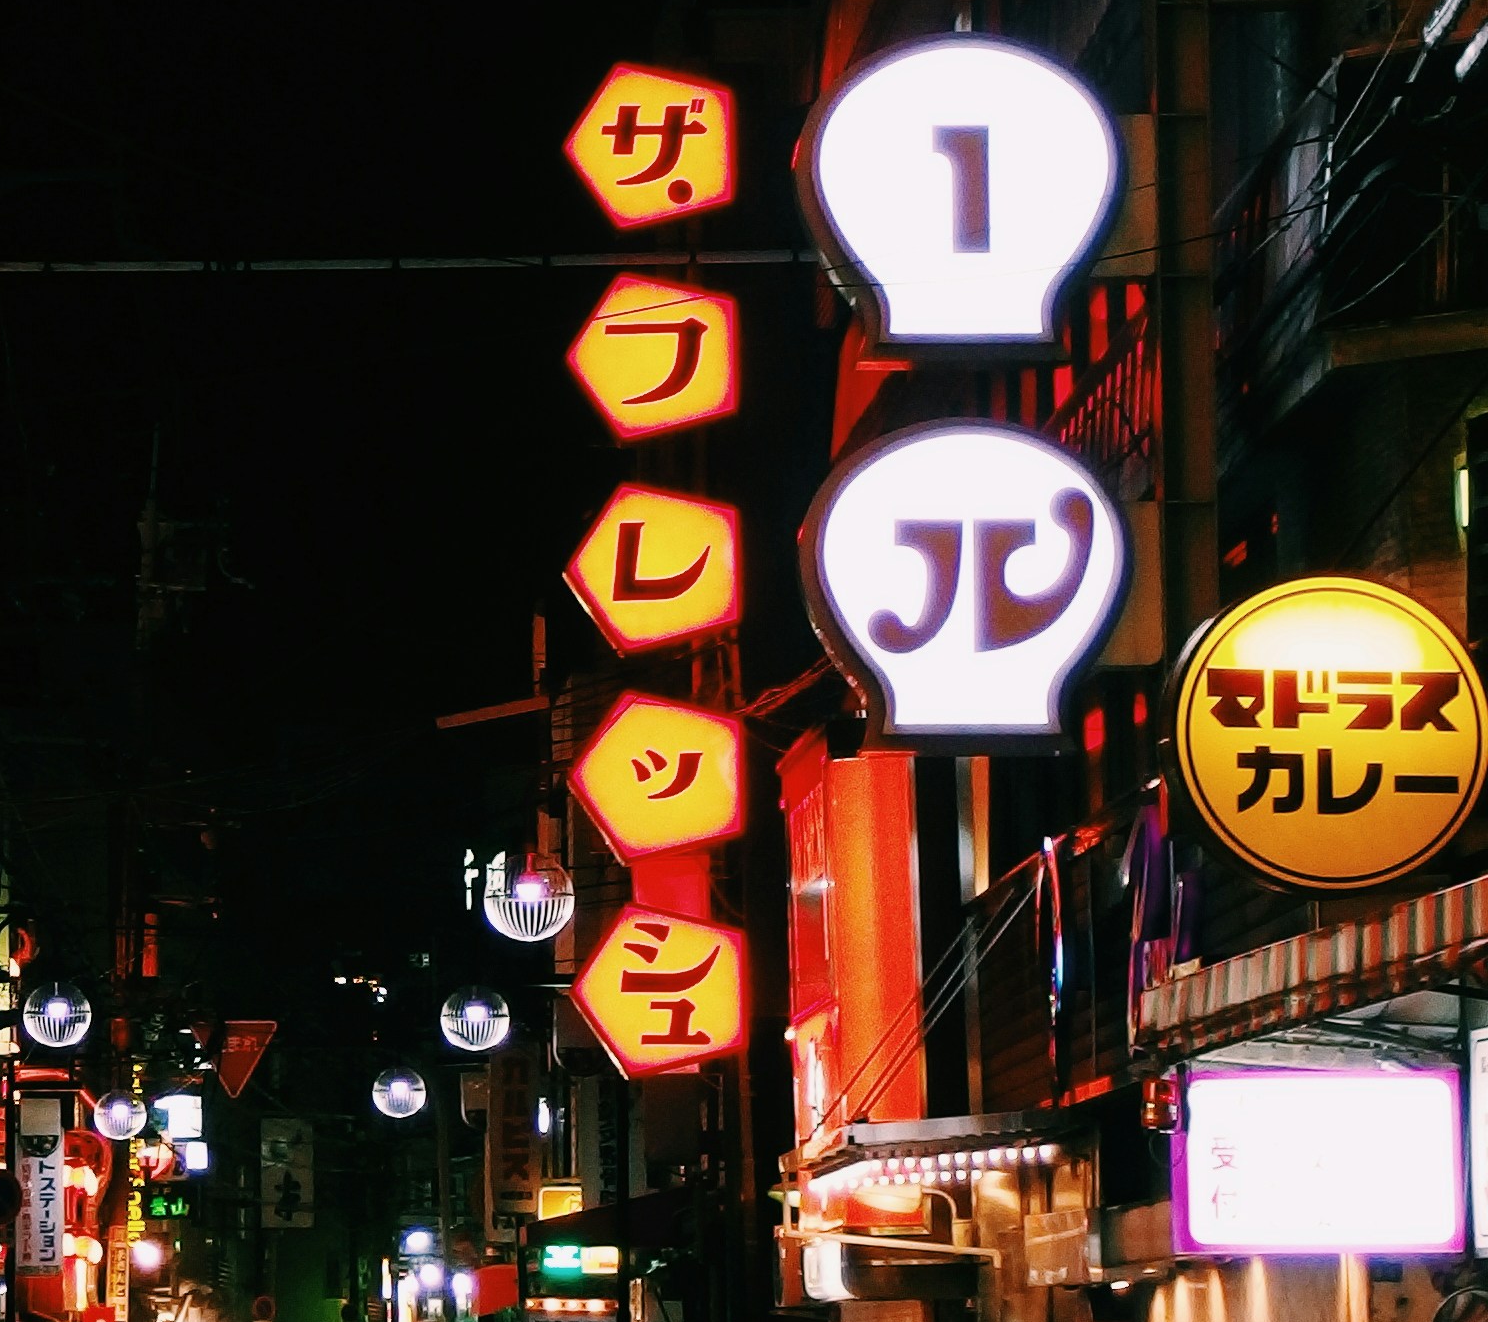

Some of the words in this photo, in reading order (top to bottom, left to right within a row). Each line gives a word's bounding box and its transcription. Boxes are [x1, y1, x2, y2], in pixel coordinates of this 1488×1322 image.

[1206, 667, 1462, 733] マドラス
[1236, 744, 1460, 815] カレー
[38, 1159, 57, 1263] トステーション
